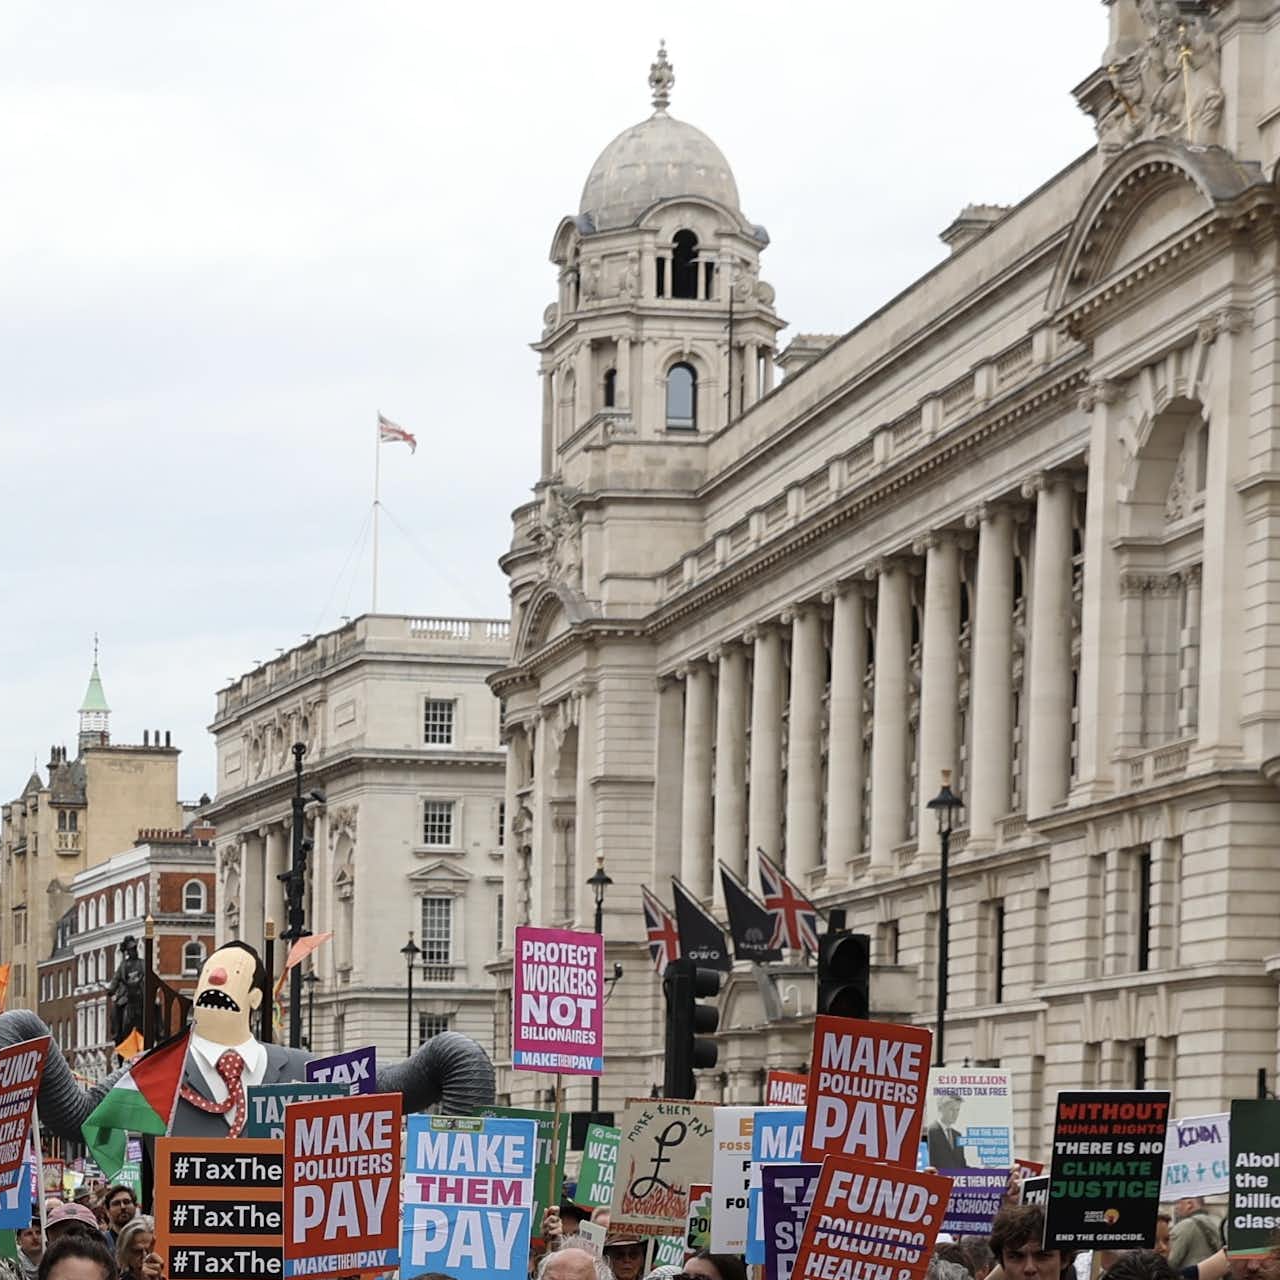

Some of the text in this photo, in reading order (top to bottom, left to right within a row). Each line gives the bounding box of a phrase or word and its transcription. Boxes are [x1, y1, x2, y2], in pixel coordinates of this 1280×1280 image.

[522, 940, 597, 967] PROTECT
[688, 950, 720, 960] OWO
[522, 963, 597, 997] WORKERS
[521, 994, 597, 1028] NOT
[521, 1026, 597, 1045] BILLIONAIRES
[821, 1032, 922, 1081] MAKE
[313, 1057, 370, 1084] TAX
[938, 1075, 1007, 1085] £10 BILLION
[771, 1080, 807, 1105] MAKE
[818, 1072, 918, 1105] POLLUTERS
[933, 1087, 1008, 1097] INHERITED TAX FREE
[252, 1096, 293, 1124] TAX
[1059, 1103, 1168, 1120] WITHOUT
[17, 1118, 25, 1139] &
[294, 1110, 393, 1158] MAKE
[628, 1111, 654, 1142] MAKE
[687, 1116, 713, 1138] PAY
[812, 1095, 916, 1162] PAY
[1057, 1124, 1165, 1135] HUMAN RIGHTS
[1177, 1124, 1222, 1148] KINDA
[416, 1131, 525, 1174] MAKE
[588, 1142, 617, 1162] WEA
[760, 1126, 803, 1160] MA
[1055, 1142, 1163, 1155] THERE IS NO
[174, 1157, 282, 1181] #TaxThe
[293, 1153, 393, 1182] POLLUTERS
[1062, 1161, 1152, 1176] CLIMATE
[416, 1176, 523, 1206] THEM
[968, 1176, 986, 1188] THEM
[1051, 1180, 1159, 1198] JUSTICE
[1235, 1173, 1269, 1188] the
[824, 1170, 940, 1226] FUND:
[956, 1199, 1000, 1215] SCHOOLS
[173, 1205, 281, 1228] #TaxThe
[293, 1177, 392, 1244] PAY
[411, 1207, 524, 1271] PAY
[608, 1222, 665, 1235] FRAGILE
[813, 1215, 926, 1264] POLLUTERS
[1055, 1233, 1145, 1241] END THE GENOCIDE.
[173, 1251, 282, 1274] #TaxThe
